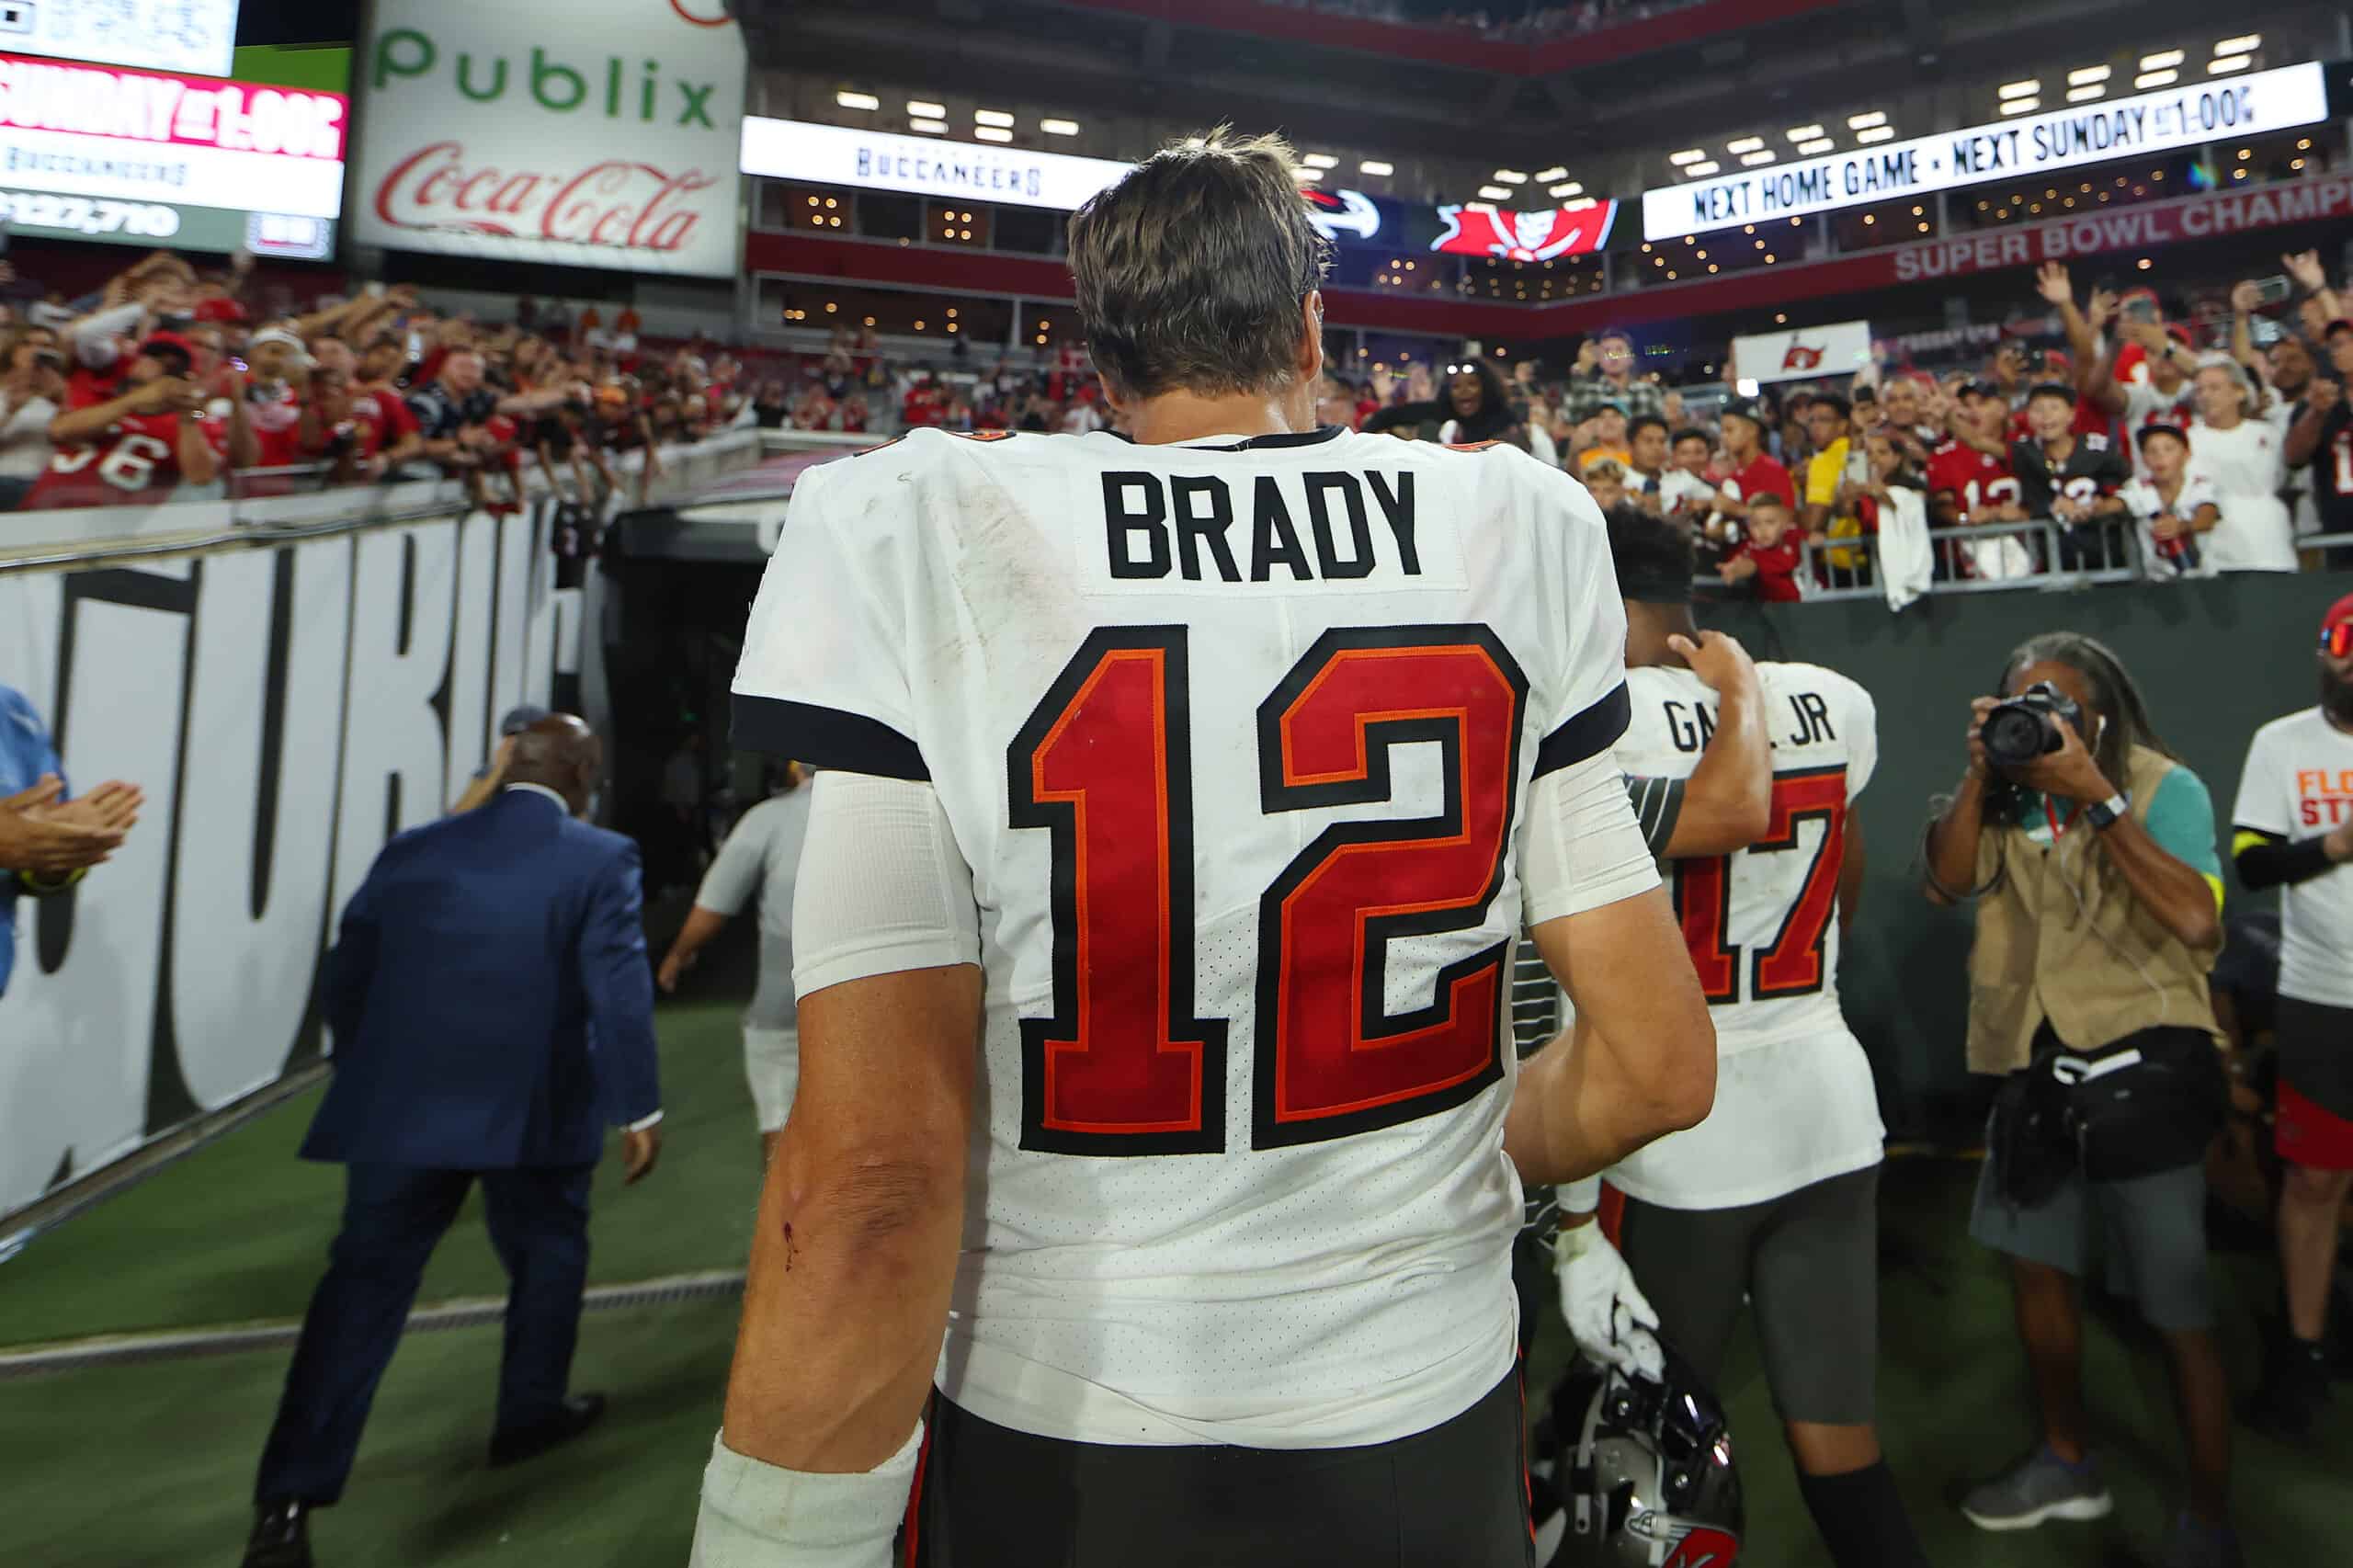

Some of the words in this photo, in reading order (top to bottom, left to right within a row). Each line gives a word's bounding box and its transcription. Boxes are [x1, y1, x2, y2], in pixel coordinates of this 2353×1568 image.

[373, 28, 716, 129] Publix
[375, 140, 720, 253] Coca-Cola
[856, 146, 1041, 197] BUCCANEERS
[1694, 180, 1751, 222] NEXT
[1763, 165, 1833, 210] HOME
[1845, 149, 1919, 196] GAME
[1952, 130, 2020, 177] NEXT
[2033, 104, 2146, 162] SUNDAY
[1895, 235, 2029, 281] SUPER
[2041, 204, 2170, 257] BOWL
[1100, 470, 1423, 584] BRADY
[1788, 691, 1837, 746] JR
[1006, 622, 1531, 1157] 12
[1672, 763, 1848, 1006] 17
